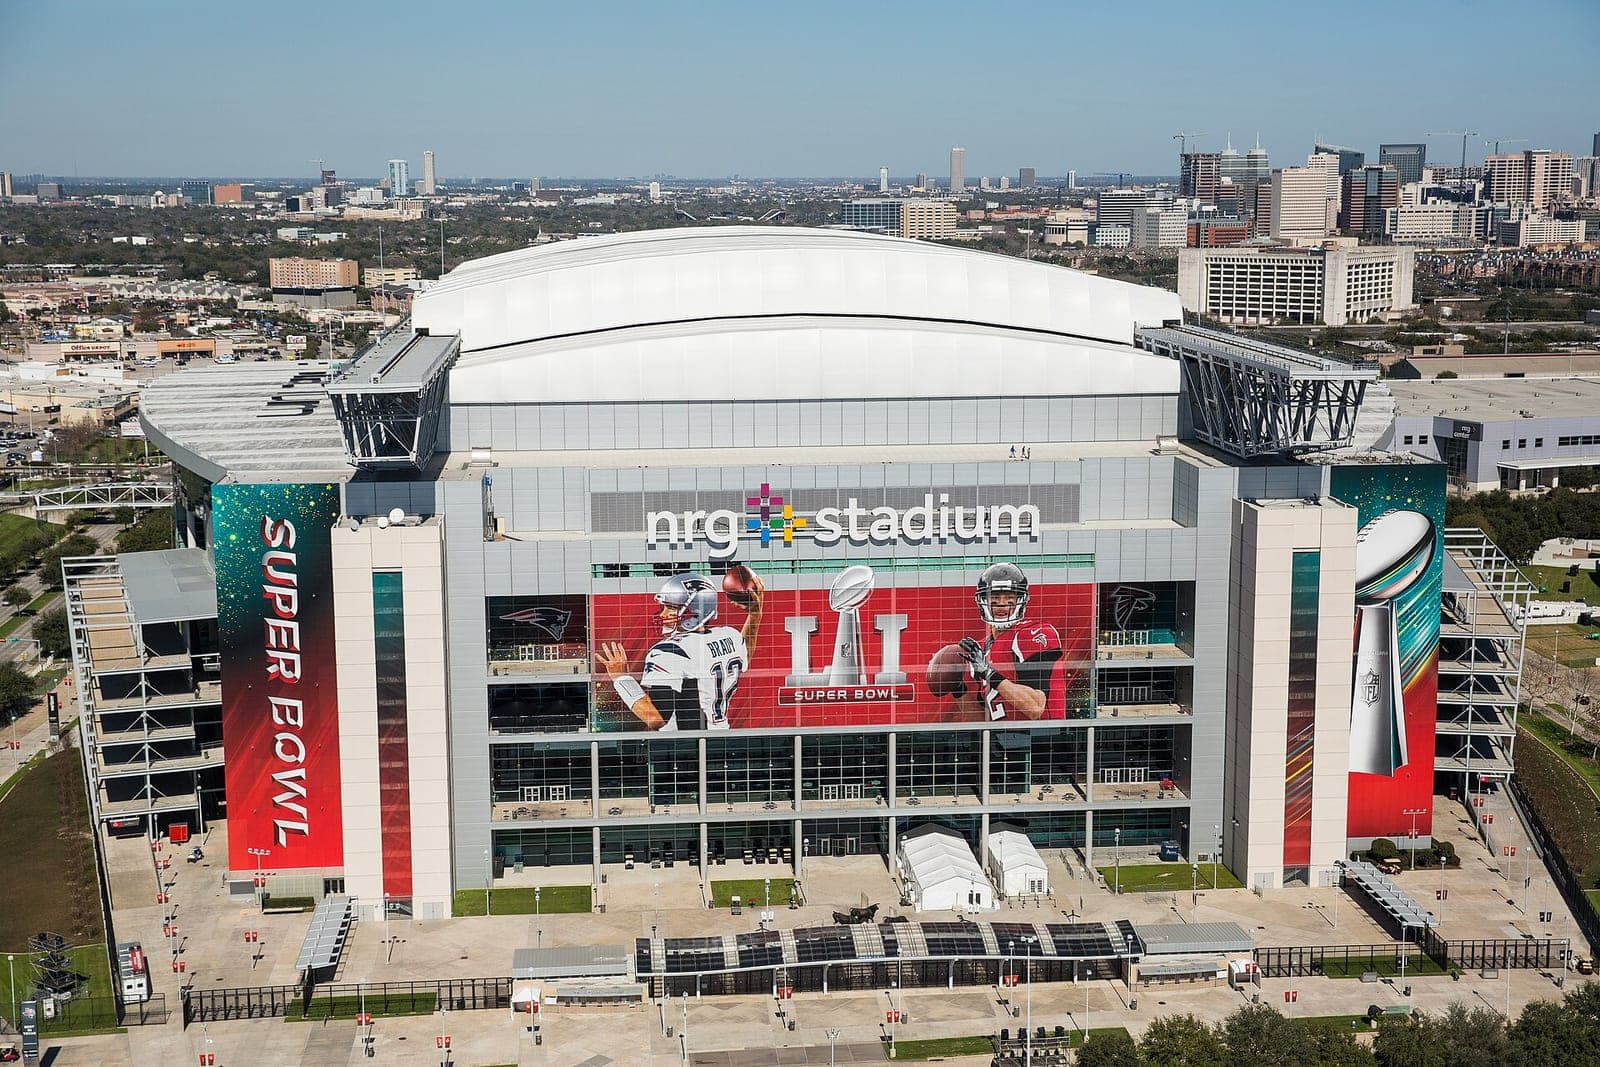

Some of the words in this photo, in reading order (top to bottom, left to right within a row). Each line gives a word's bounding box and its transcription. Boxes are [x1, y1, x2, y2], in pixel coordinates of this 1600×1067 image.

[647, 509, 739, 556] nrg
[814, 493, 1039, 542] stadium
[260, 514, 302, 684] SUPER
[706, 636, 736, 658] BRADY
[710, 656, 744, 724] 12
[794, 690, 847, 701] SUPER
[854, 689, 899, 699] BOWL
[268, 696, 309, 848] BOWL
